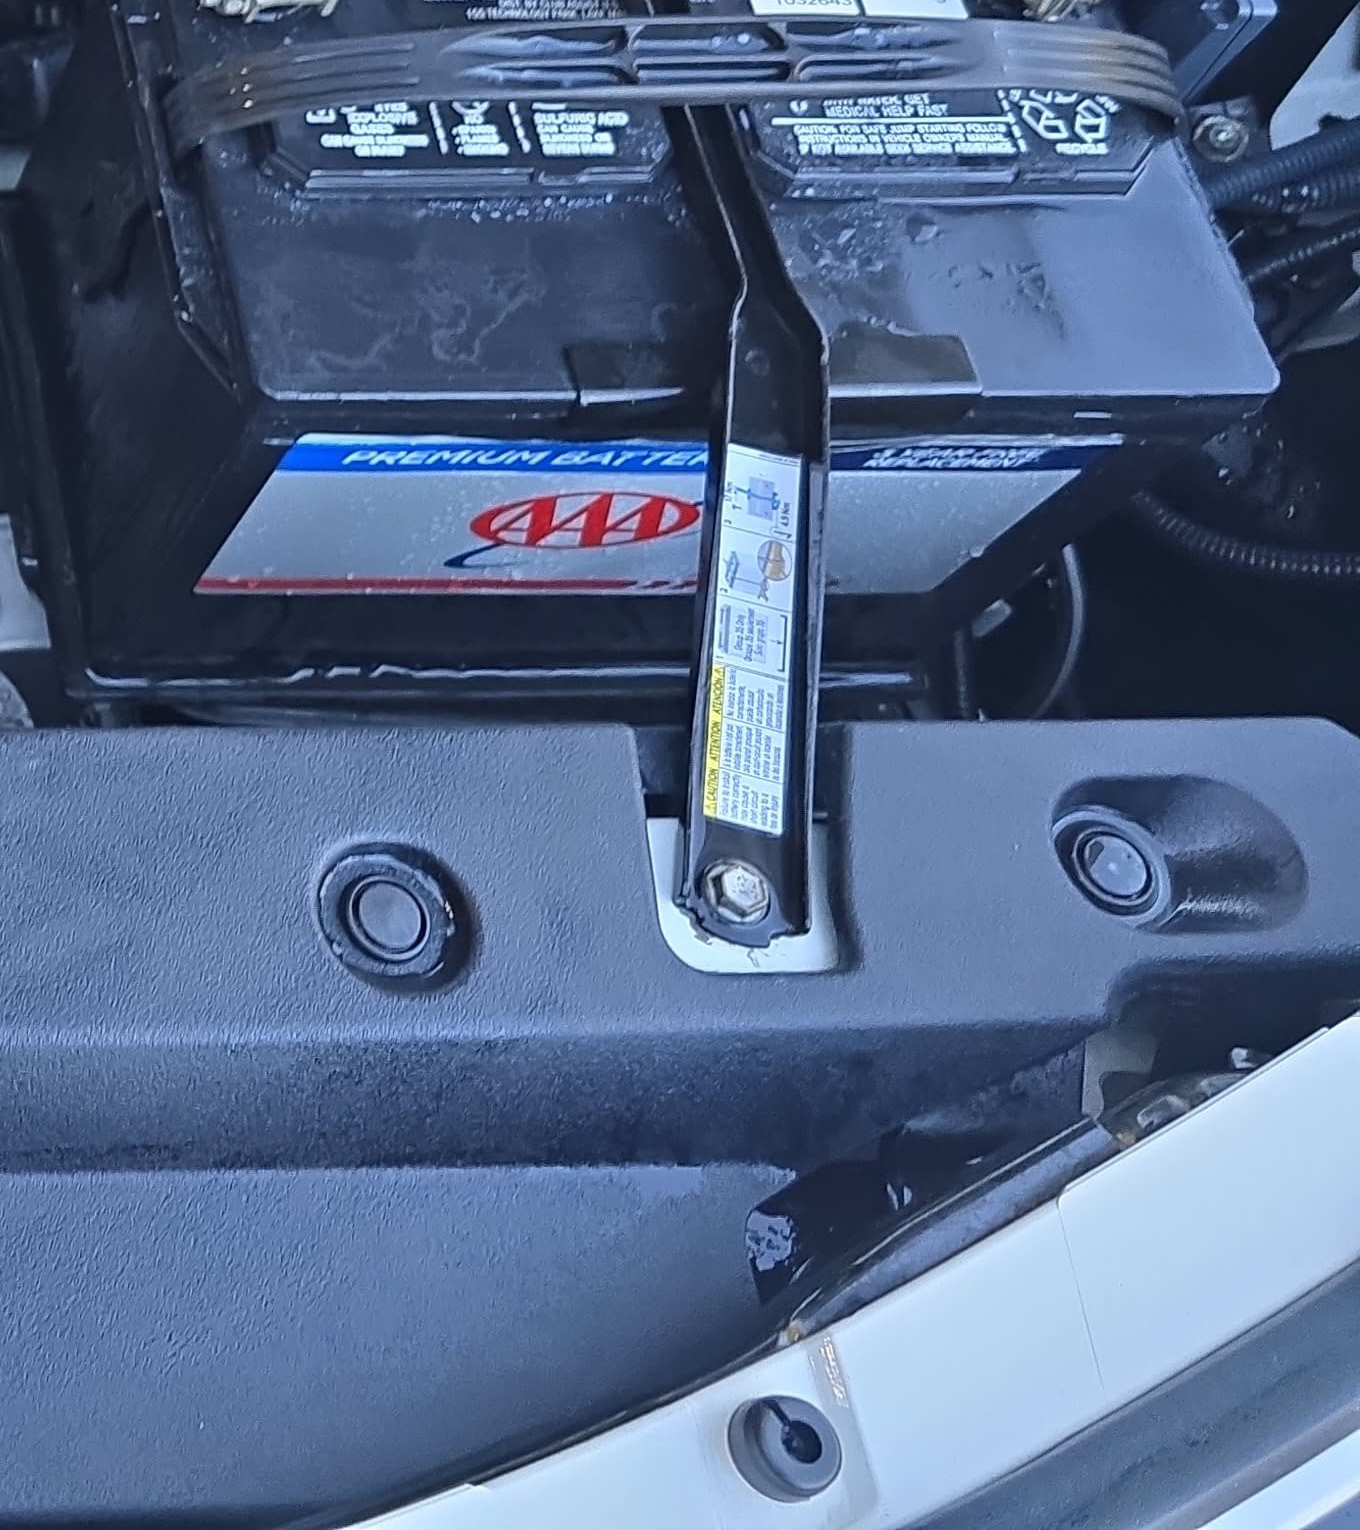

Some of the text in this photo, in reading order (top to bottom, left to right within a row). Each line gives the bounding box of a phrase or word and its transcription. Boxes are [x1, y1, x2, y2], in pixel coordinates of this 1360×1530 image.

[533, 111, 596, 125] SULFURIC
[824, 106, 880, 118] MEDICAL
[881, 105, 915, 118] HELP
[838, 125, 862, 135] FOR
[862, 125, 887, 135] SAFE
[916, 124, 965, 134] STARTING
[798, 134, 868, 145] INSTRUCTIONS
[882, 134, 922, 144] VEHICLE
[342, 449, 552, 466] PREMIUM
[483, 491, 680, 548] AAA
[709, 720, 721, 761] ATTENTION
[706, 768, 718, 801] CAUTION
